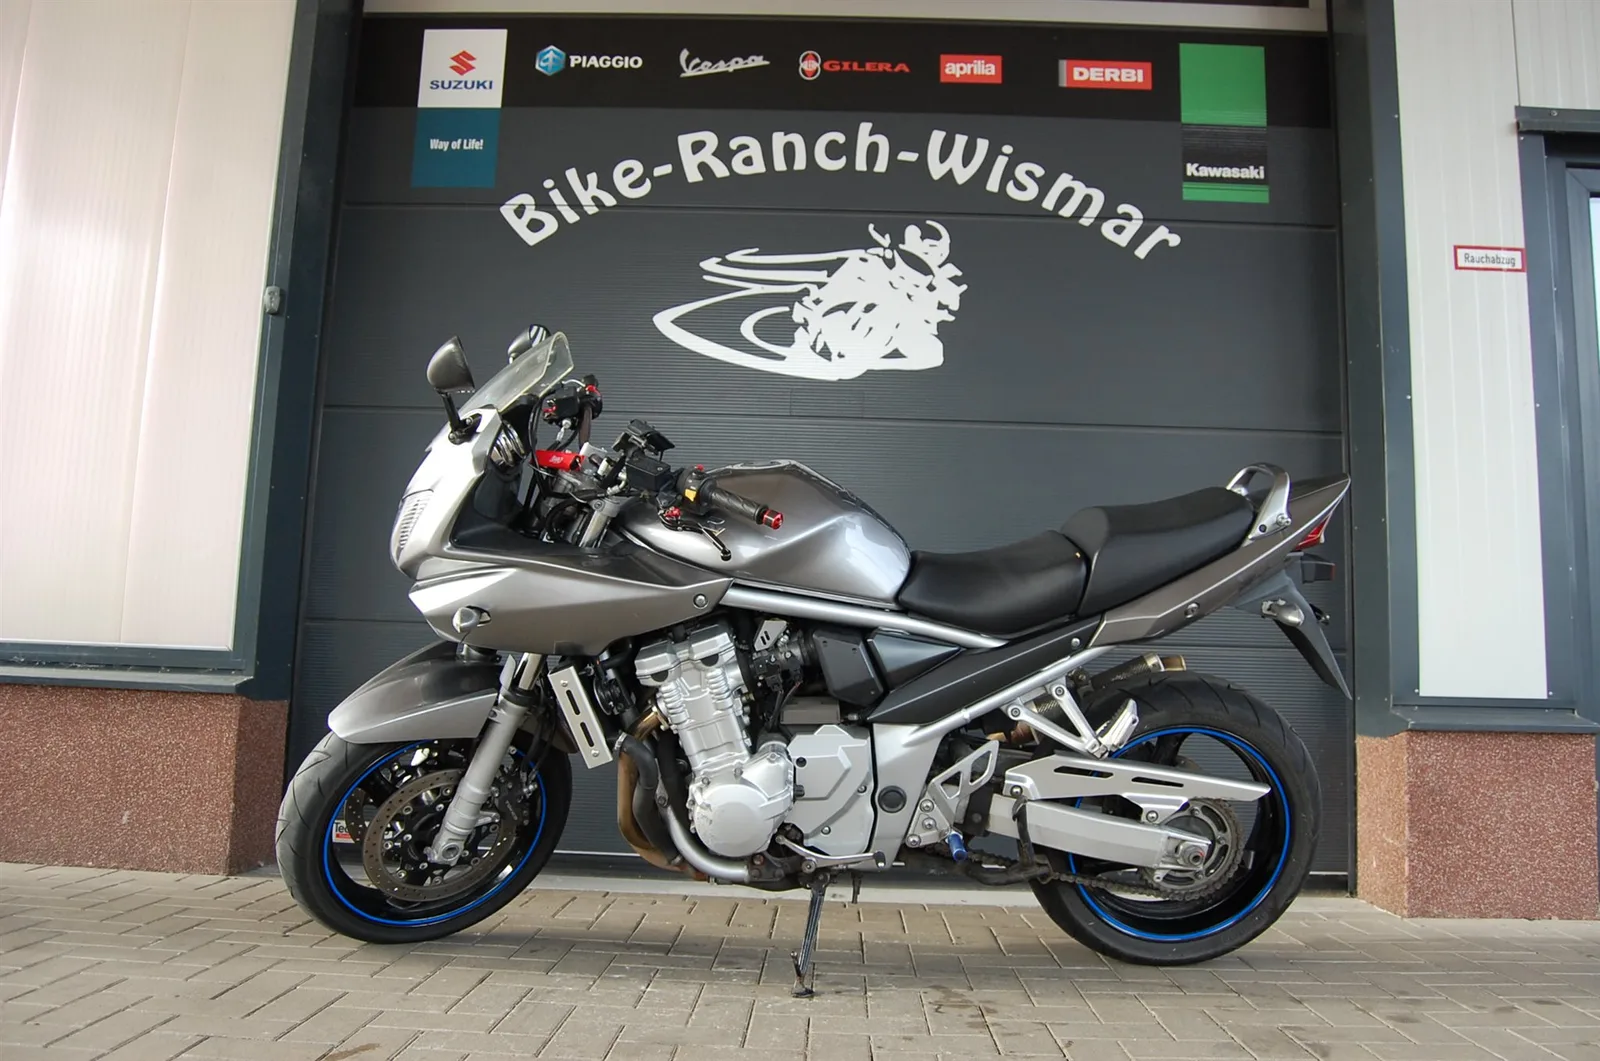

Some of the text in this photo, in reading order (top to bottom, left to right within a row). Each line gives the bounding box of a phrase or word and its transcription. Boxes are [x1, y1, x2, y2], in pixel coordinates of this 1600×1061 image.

[569, 55, 643, 69] PIAGGIO
[679, 48, 770, 77] Vespa
[823, 60, 910, 73] GILERA
[945, 60, 996, 77] aprilia
[1073, 67, 1144, 83] DERBI
[430, 80, 493, 90] SUZUKI
[430, 138, 484, 151] Way of Life!
[1186, 162, 1265, 179] Kawasaki
[1464, 252, 1516, 267] Rauchabzug
